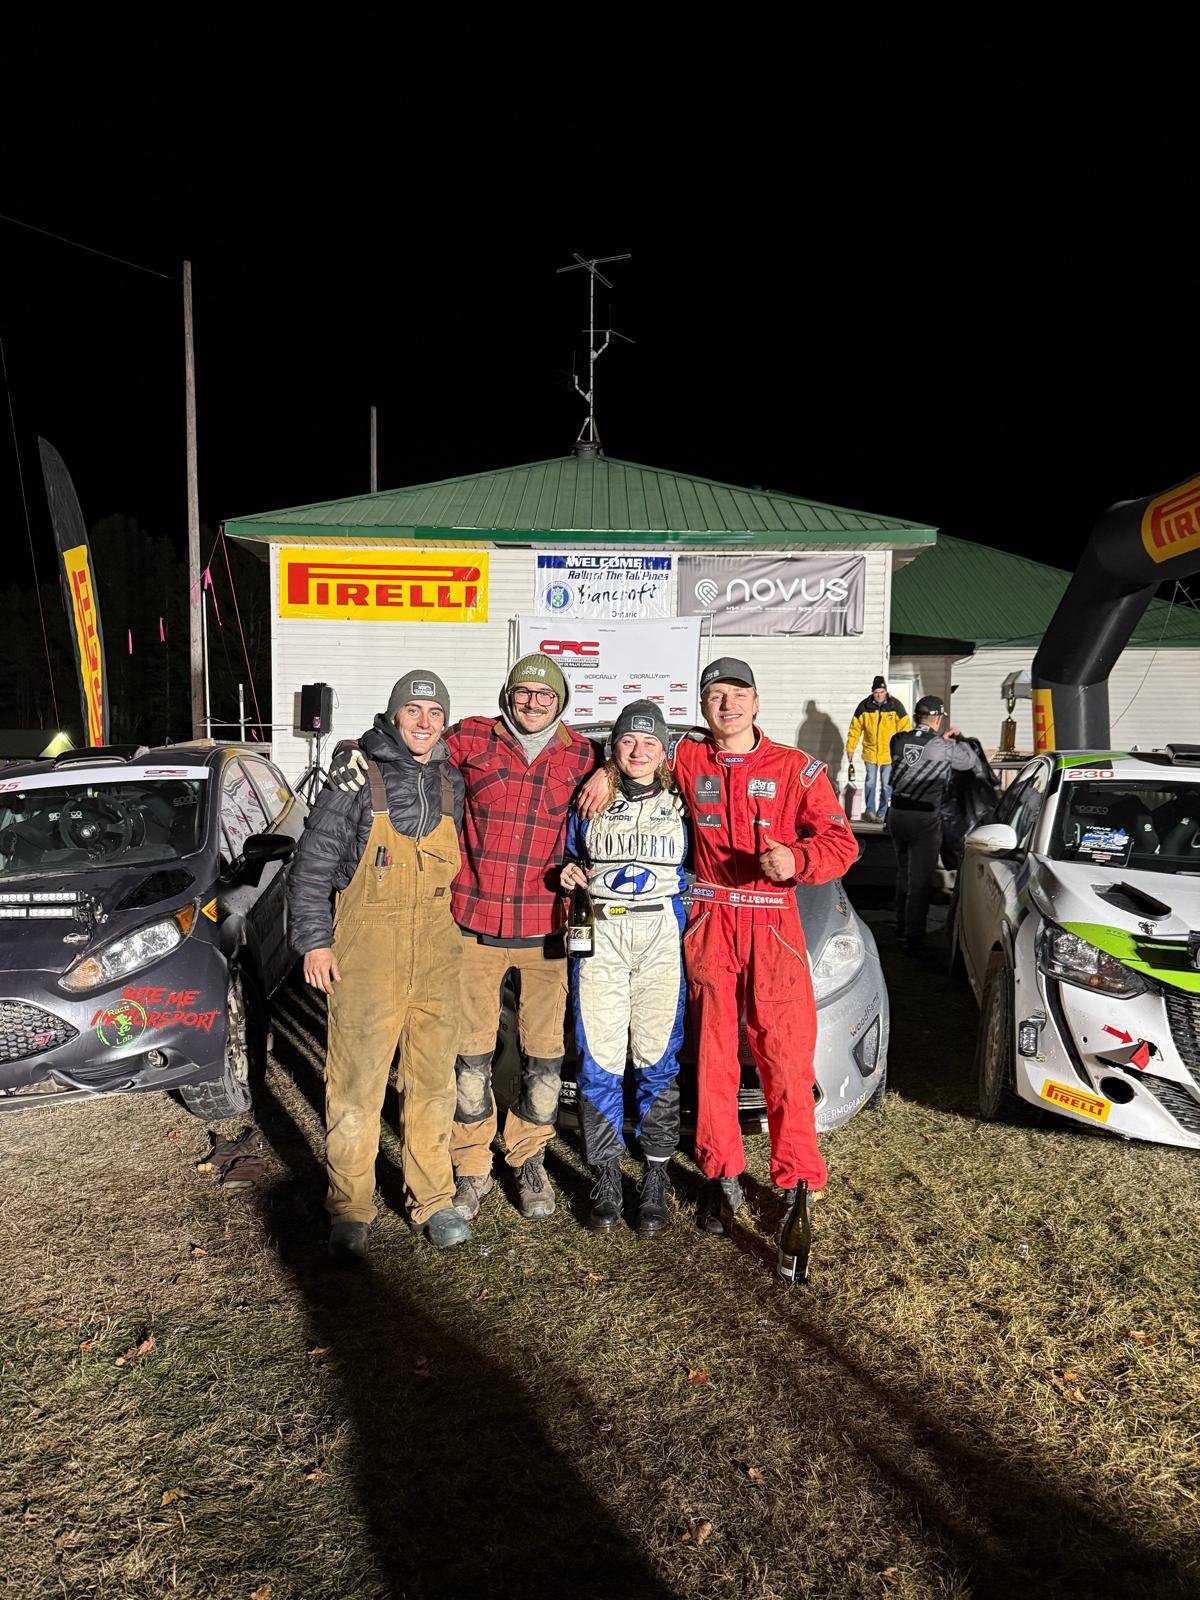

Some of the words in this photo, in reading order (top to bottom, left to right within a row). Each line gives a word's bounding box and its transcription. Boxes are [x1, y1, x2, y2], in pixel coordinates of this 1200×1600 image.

[1150, 487, 1200, 548] PIR
[566, 556, 643, 569] WELCOME
[568, 571, 592, 580] Rally
[606, 571, 623, 580] The
[642, 571, 669, 581] Pines
[288, 563, 480, 607] PIRELLI
[726, 578, 848, 601] novus
[540, 640, 599, 655] CRC
[1068, 770, 1115, 779] 230
[49, 811, 82, 821] spco
[595, 832, 675, 859] CONCERTO
[740, 896, 784, 905] C.L'ESTAGE
[609, 906, 626, 915] OMP
[164, 991, 200, 1009] ME
[107, 1005, 129, 1016] Race
[90, 1008, 221, 1032] MTORSPORT
[116, 1034, 133, 1045] Lab
[1046, 1084, 1105, 1117] PIRELLI
